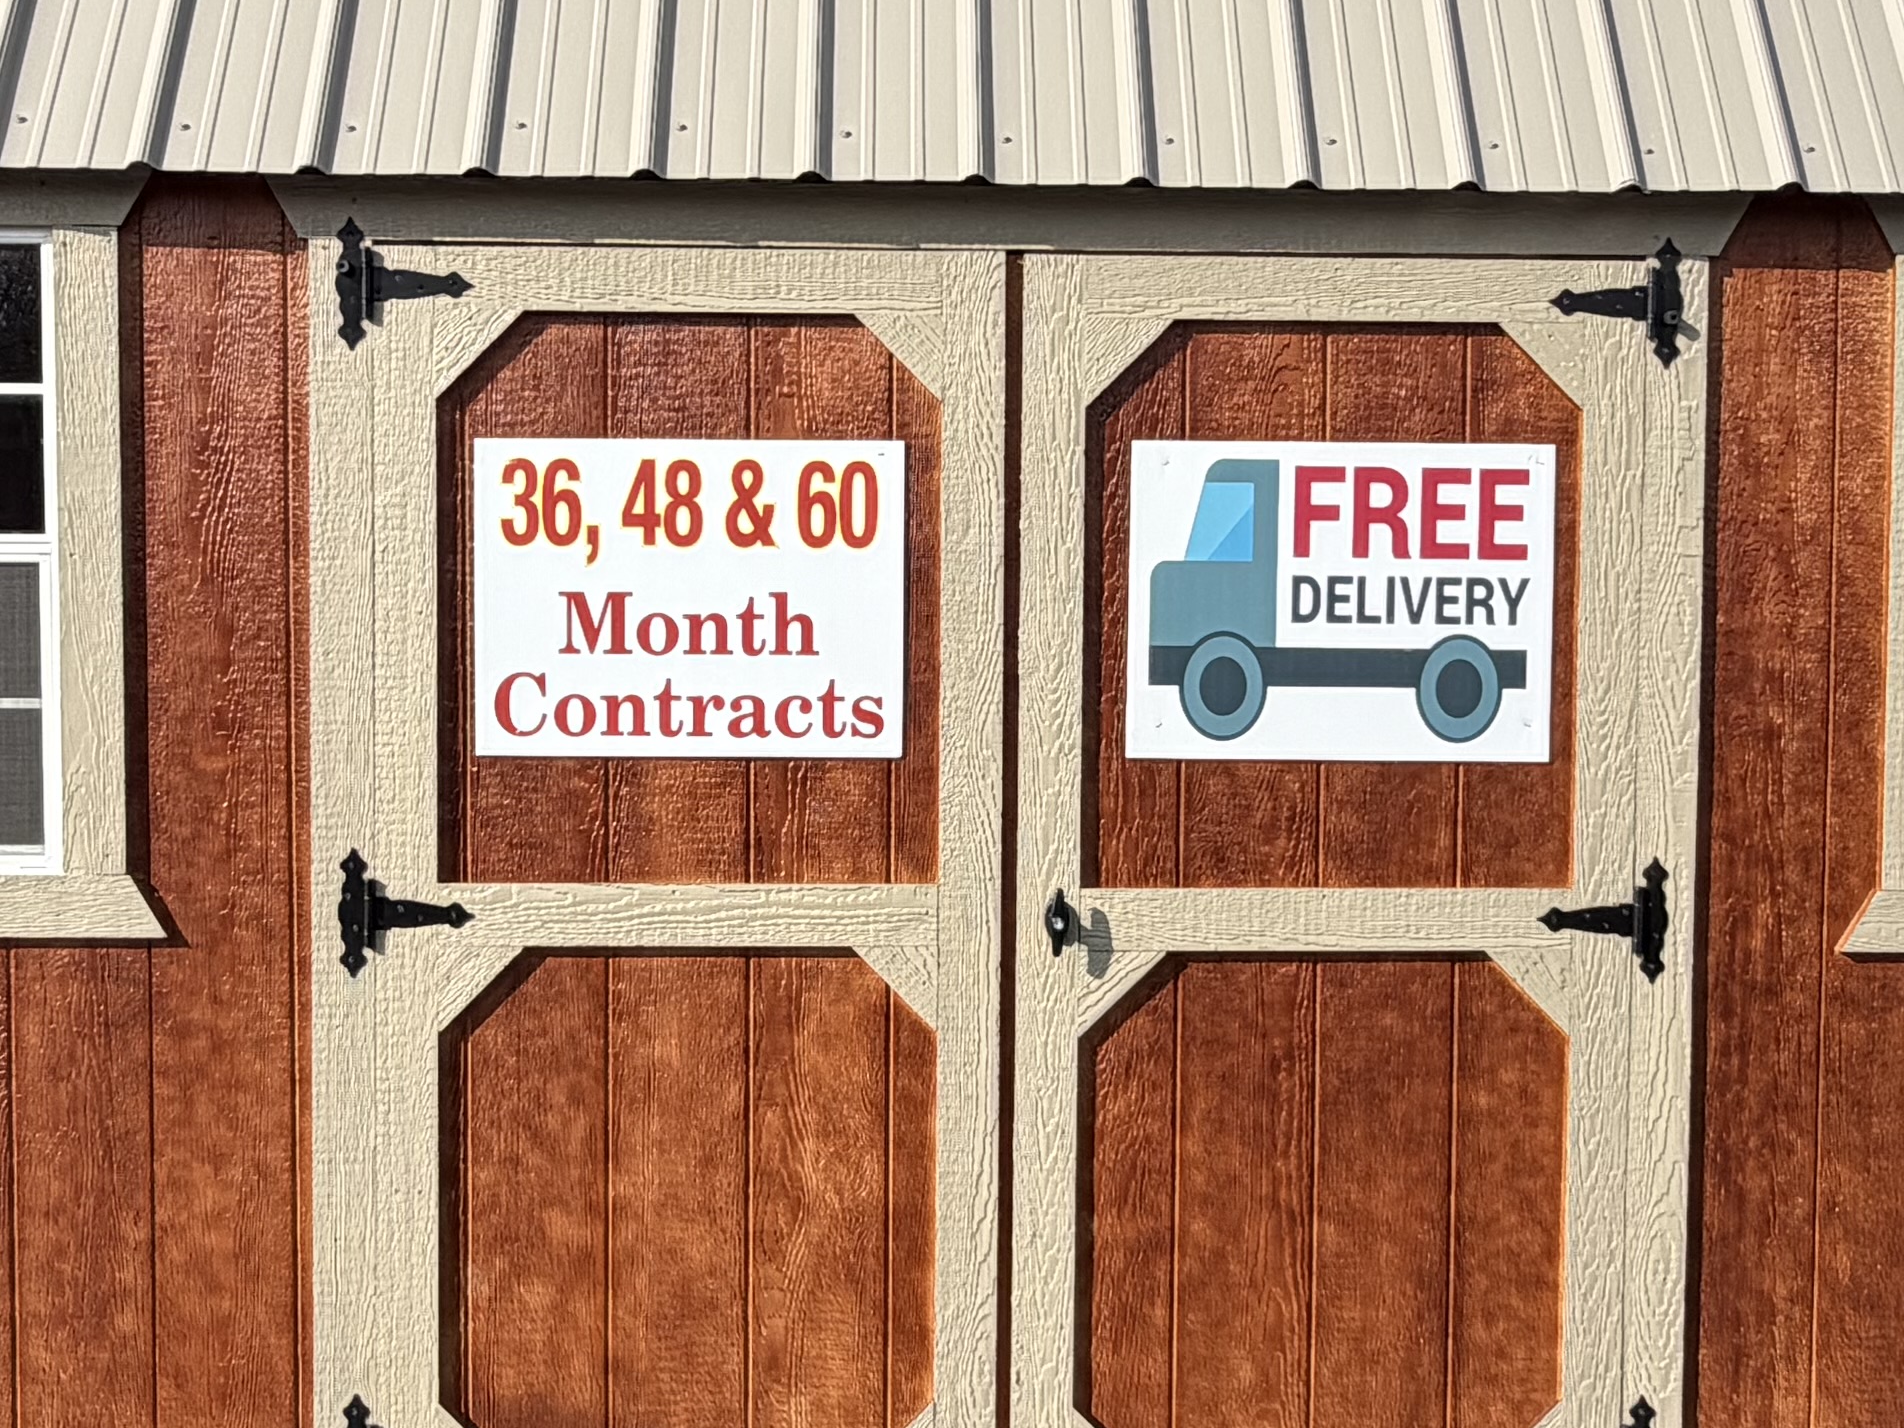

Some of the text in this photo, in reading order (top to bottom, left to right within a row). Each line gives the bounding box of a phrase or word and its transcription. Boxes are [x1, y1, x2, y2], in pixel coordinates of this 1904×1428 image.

[499, 457, 879, 567] 36, 48 & 60
[1293, 465, 1530, 560] FREE
[558, 591, 820, 656] Month
[1291, 574, 1530, 626] DELIVERY
[494, 672, 885, 739] Contracts
